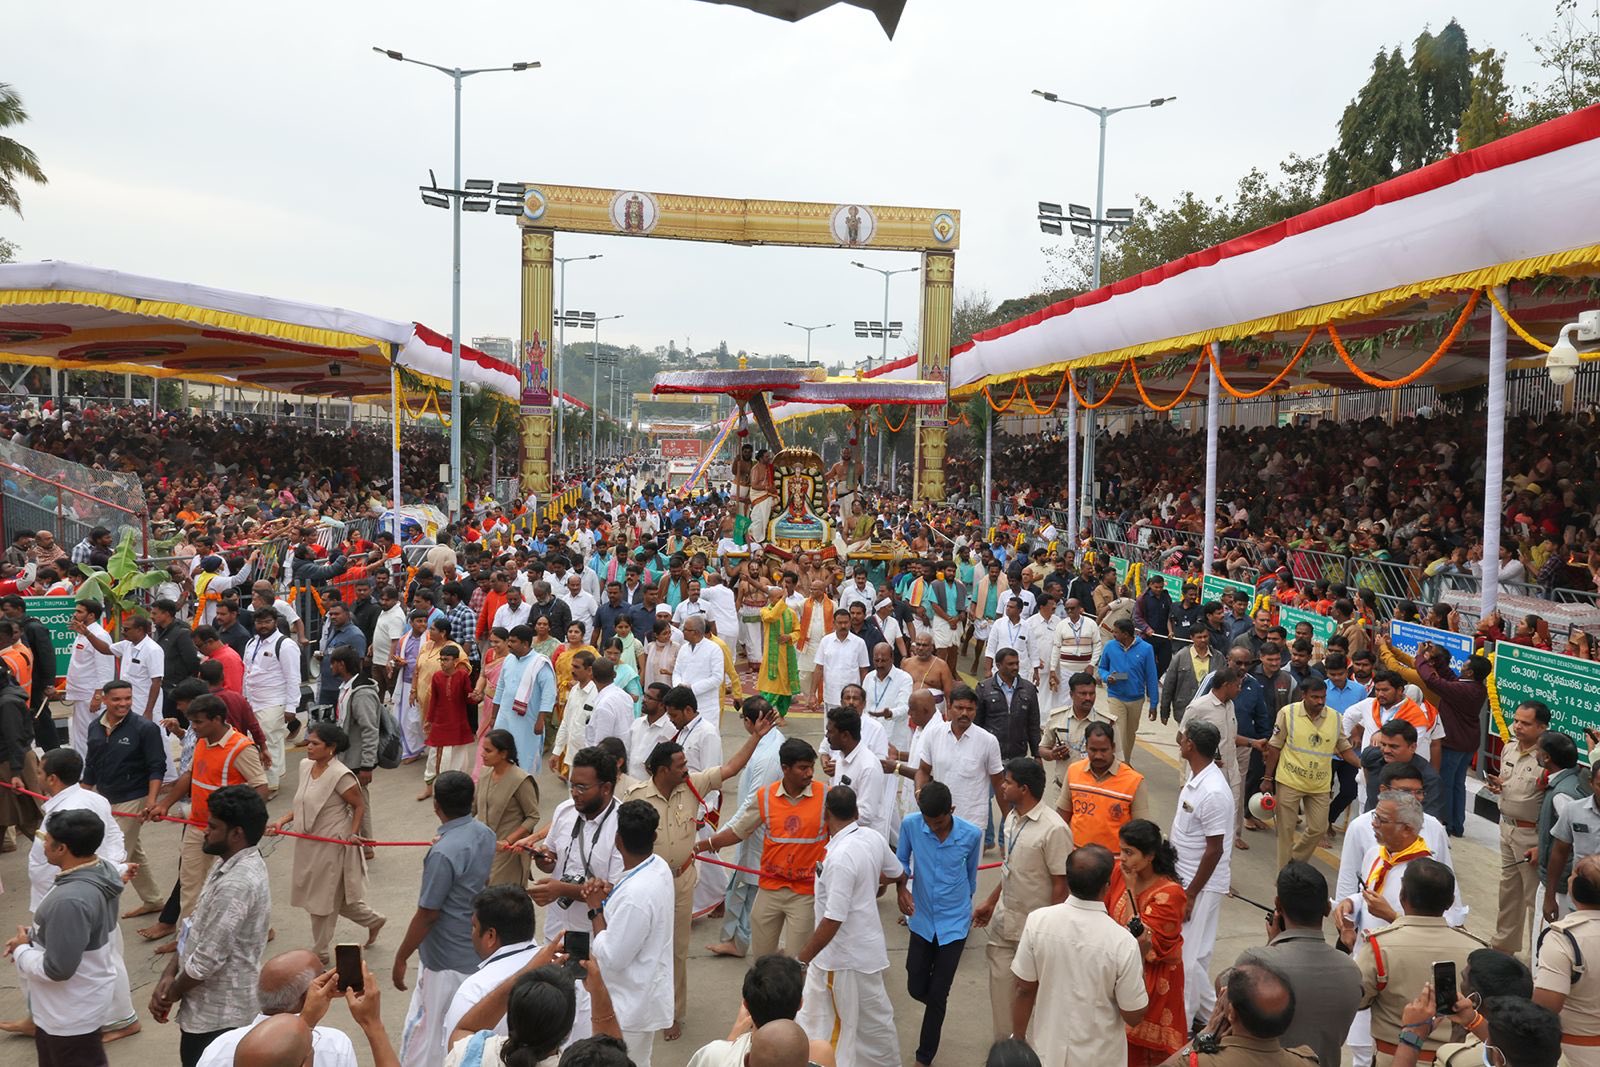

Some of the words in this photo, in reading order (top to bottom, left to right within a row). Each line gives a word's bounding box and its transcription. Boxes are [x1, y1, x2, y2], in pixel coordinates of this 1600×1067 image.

[49, 630, 76, 640] Tem
[1499, 694, 1516, 709] Way
[1576, 698, 1583, 709] 2
[1557, 724, 1586, 742] Compl
[1073, 799, 1097, 817] C92
